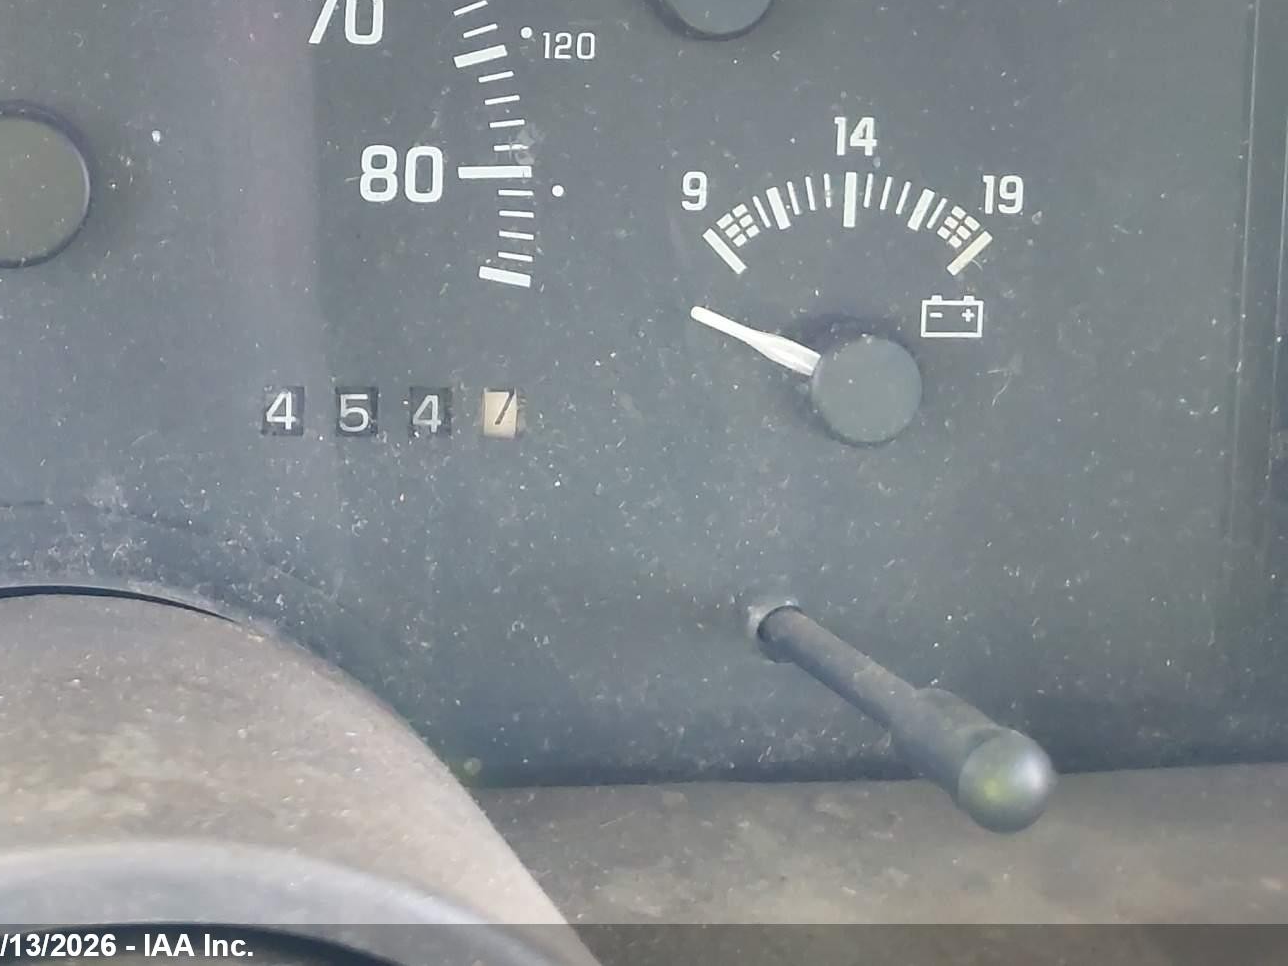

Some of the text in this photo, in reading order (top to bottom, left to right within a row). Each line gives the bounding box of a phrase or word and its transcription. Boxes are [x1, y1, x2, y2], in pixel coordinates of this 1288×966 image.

[543, 33, 595, 59] 120
[835, 117, 877, 155] 14
[360, 145, 443, 202] 80
[682, 172, 707, 210] 9
[983, 176, 1023, 214] 19
